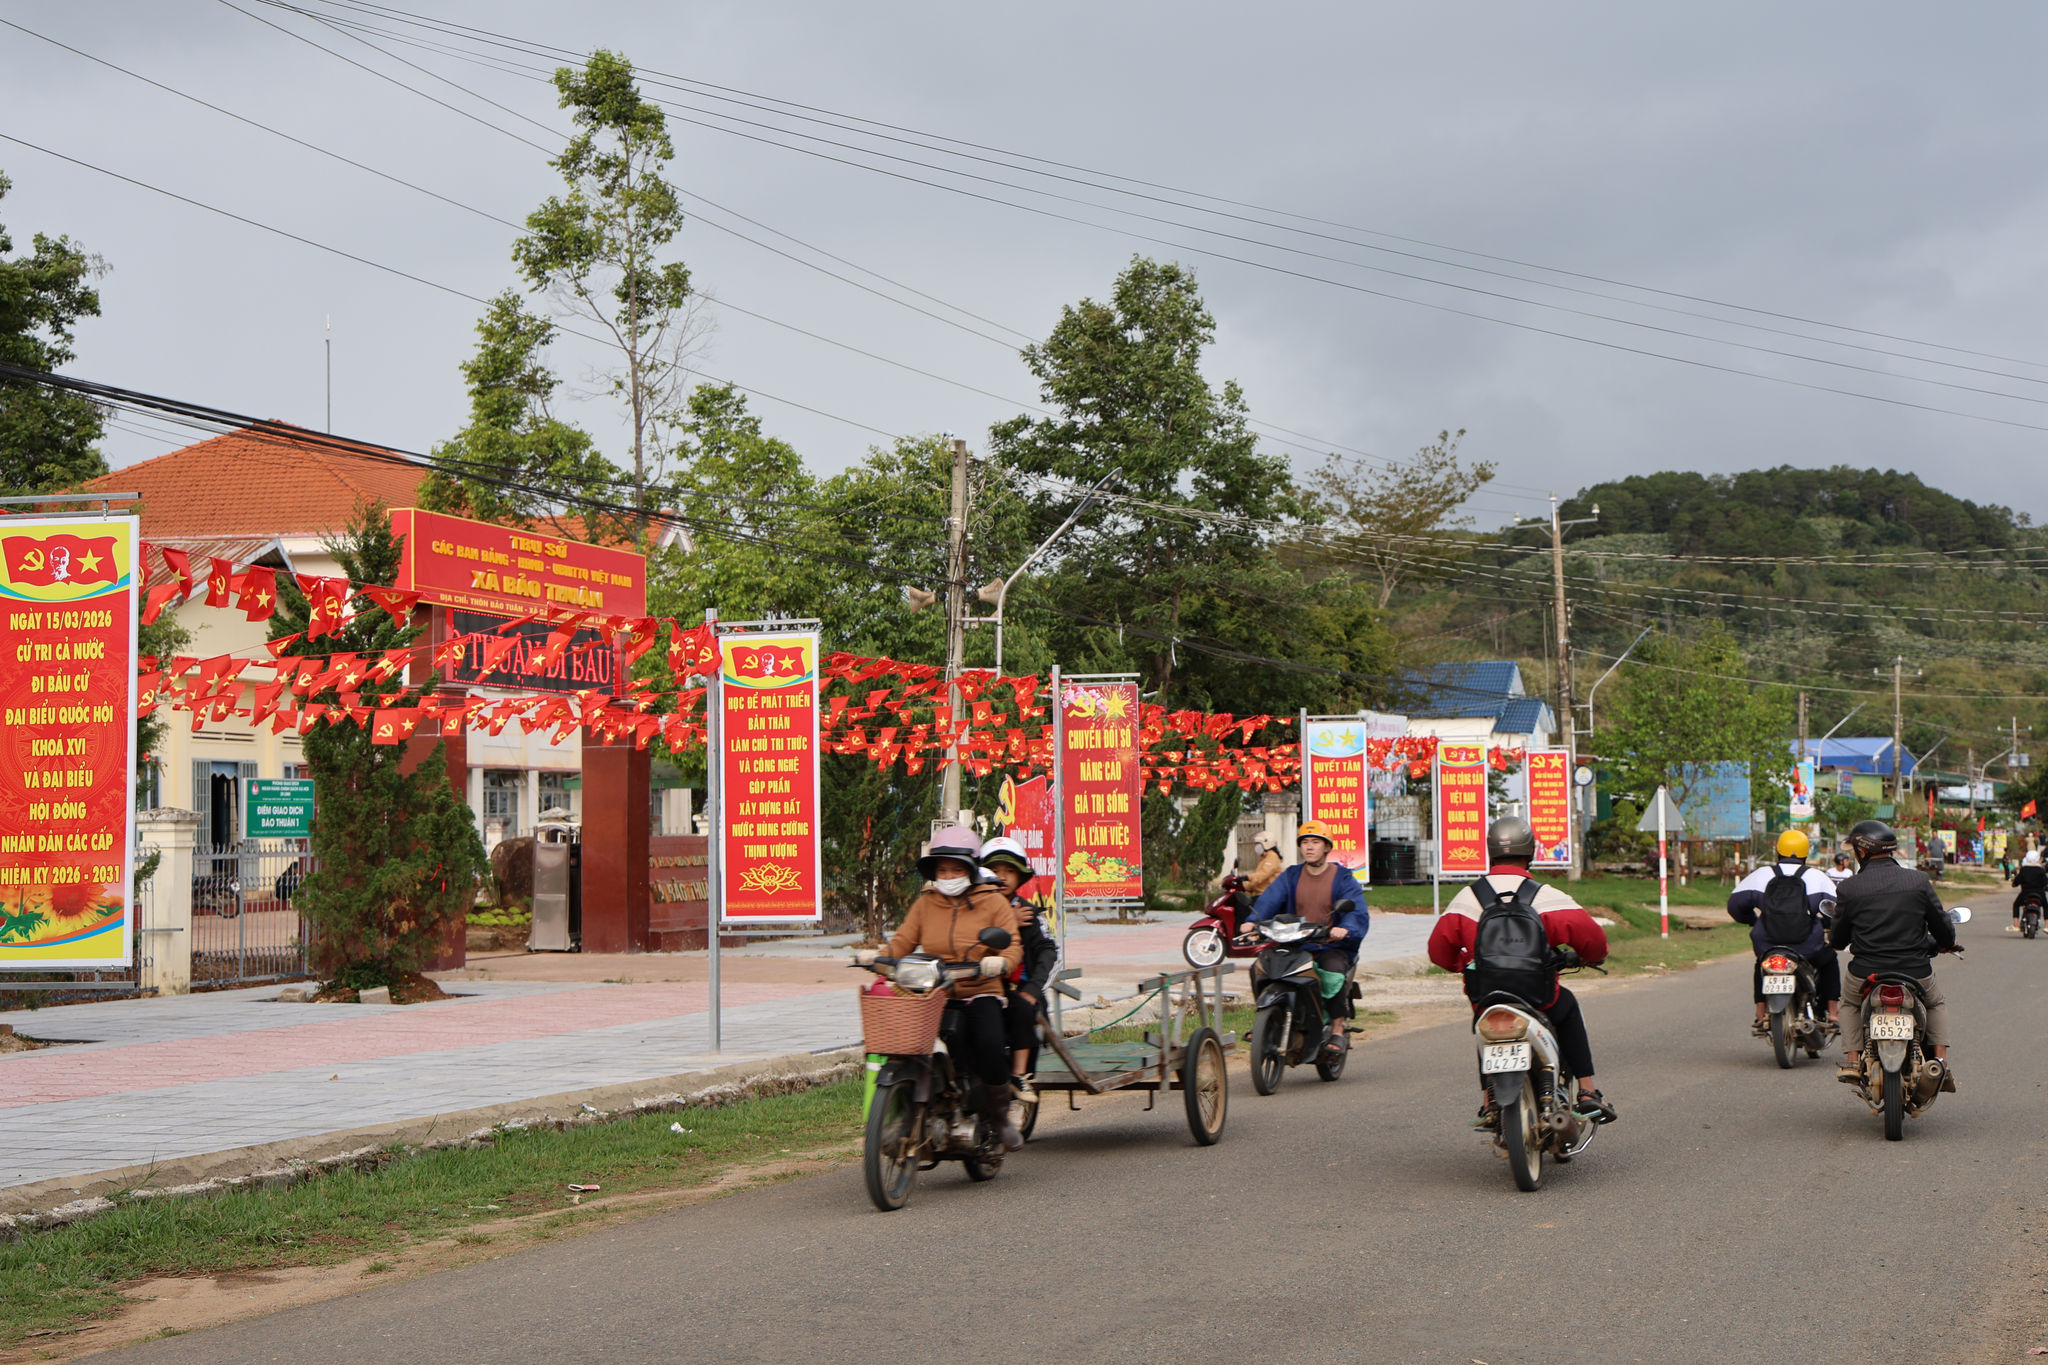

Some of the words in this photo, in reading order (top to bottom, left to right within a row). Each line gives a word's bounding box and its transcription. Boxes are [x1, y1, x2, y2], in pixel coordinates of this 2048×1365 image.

[509, 535, 542, 557] TRỤ
[545, 541, 567, 558] SỞ
[432, 540, 453, 555] CÁC
[591, 569, 609, 585] VIỆT
[611, 574, 632, 588] NAM
[472, 569, 499, 592] XÃ
[503, 573, 541, 598] BẢO
[544, 582, 603, 609] THUẬN
[10, 608, 42, 630] NGÀY
[46, 610, 112, 630] 15/03/2026
[17, 638, 33, 662] CỬ
[35, 644, 52, 661] TRI
[56, 636, 71, 660] CẢ
[73, 637, 105, 660] NƯỚC
[31, 676, 44, 693] ĐI
[74, 668, 90, 692] CỬ
[728, 696, 745, 712] HỌC
[747, 691, 759, 709] ĐỂ
[761, 693, 783, 709] PHÁT
[785, 689, 810, 708] TRIỂN
[5, 708, 26, 730] ĐẠI
[29, 699, 56, 725] BIỂU
[59, 699, 90, 725] QUỐC
[93, 700, 114, 727] HỘI
[748, 714, 766, 730] BẢN
[768, 714, 790, 730] THÂN
[32, 733, 64, 757] KHOÁ
[66, 738, 86, 756] XVI
[731, 736, 750, 752] LÀM
[751, 734, 768, 752] CHỦ
[770, 738, 784, 751] TRI
[786, 734, 808, 751] THỨC
[1068, 722, 1101, 750] CHUYỂN
[1104, 722, 1119, 749] ĐỔI
[1120, 722, 1131, 748] SỐ
[24, 766, 40, 789] VÀ
[42, 770, 63, 792] ĐẠI
[66, 761, 93, 788] BIỂU
[739, 757, 751, 773] VÀ
[753, 757, 776, 773] CÔNG
[778, 756, 800, 775] NGHỆ
[1080, 758, 1103, 781] NÂNG
[1105, 761, 1122, 781] CAO
[1313, 759, 1340, 773] QUYẾT
[1342, 760, 1361, 772] TÂM
[749, 778, 766, 794] GÓP
[1317, 776, 1334, 788] XÂY
[1336, 776, 1358, 789] DỰNG
[739, 800, 757, 816] XÂY
[759, 800, 781, 818] DỰNG
[784, 798, 801, 815] ĐẤT
[1075, 790, 1089, 814] GIÁ
[1091, 794, 1104, 817] TRỊ
[1106, 788, 1128, 814] SỐNG
[1320, 791, 1339, 804] KHỐI
[1341, 793, 1356, 805] ĐẠI
[1450, 789, 1463, 807] VIỆT
[29, 798, 49, 824] HỘI
[272, 805, 288, 815] GIAO
[1318, 808, 1340, 819] ĐOÀN
[1342, 806, 1358, 819] KẾT
[1, 830, 35, 853] NHÂN
[38, 830, 63, 852] DÂN
[66, 828, 88, 852] CÁC
[91, 825, 114, 851] CẤP
[732, 821, 754, 837] NƯỚC
[757, 821, 779, 836] HÙNG
[781, 820, 809, 836] CƯỜNG
[1075, 822, 1087, 846] VÀ
[1089, 822, 1108, 846] LÀM
[1110, 822, 1130, 850] VIỆC
[744, 844, 767, 860] THỊNH
[770, 843, 798, 860] VƯỢNG
[1341, 839, 1357, 852] TỘC
[0, 862, 31, 889] HIỆM
[34, 861, 49, 884] KỲ
[52, 866, 80, 884] 2026
[92, 865, 120, 883] 2031
